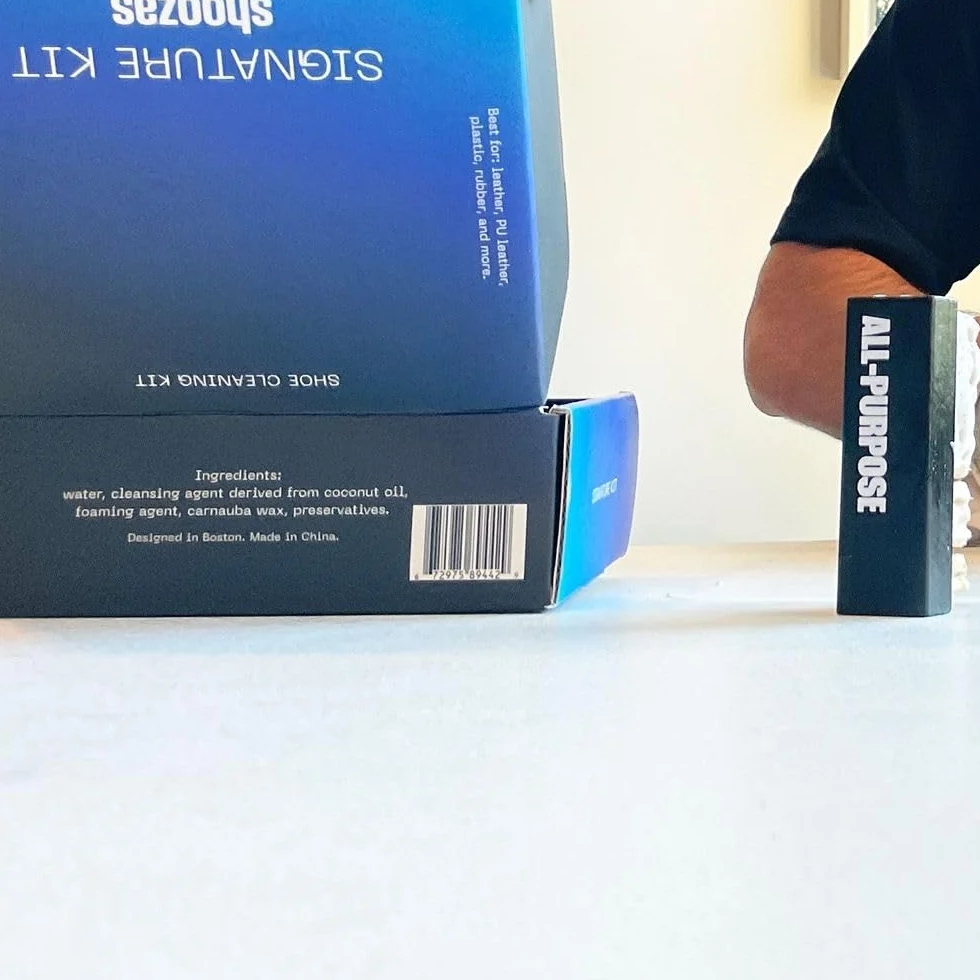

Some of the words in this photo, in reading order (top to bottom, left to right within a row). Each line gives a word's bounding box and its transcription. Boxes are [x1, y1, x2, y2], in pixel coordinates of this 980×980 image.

[11, 46, 96, 80] KIT
[115, 47, 384, 82] SIGNATURE
[487, 108, 500, 136] Best
[469, 116, 485, 165] plastic,
[490, 140, 502, 163] for:
[475, 170, 488, 214] rubber,
[491, 167, 505, 215] leather,
[478, 219, 491, 242] and
[495, 219, 508, 236] PU
[480, 246, 491, 280] more.
[497, 240, 509, 286] leather,
[135, 374, 171, 387] KIT
[177, 374, 281, 387] CLEANING
[289, 374, 340, 386] SHOE
[857, 315, 892, 514] ALL-PURPOSE
[194, 469, 282, 483] Ingredients:
[62, 489, 106, 501] water,
[111, 488, 180, 501] cleansing
[184, 488, 224, 501] agent
[229, 486, 282, 499] derived
[286, 486, 319, 498] from
[324, 486, 380, 498] coconut
[384, 485, 408, 499] oil,
[75, 505, 135, 519] foaming
[138, 506, 182, 519] agent,
[187, 505, 251, 517] carnauba
[256, 507, 288, 518] wax,
[292, 504, 390, 517] preservatives.
[127, 532, 183, 545] Designed
[186, 531, 199, 543] in
[202, 531, 246, 543] Boston.
[249, 531, 281, 542] Made
[285, 531, 298, 542] in
[301, 530, 340, 542] China.
